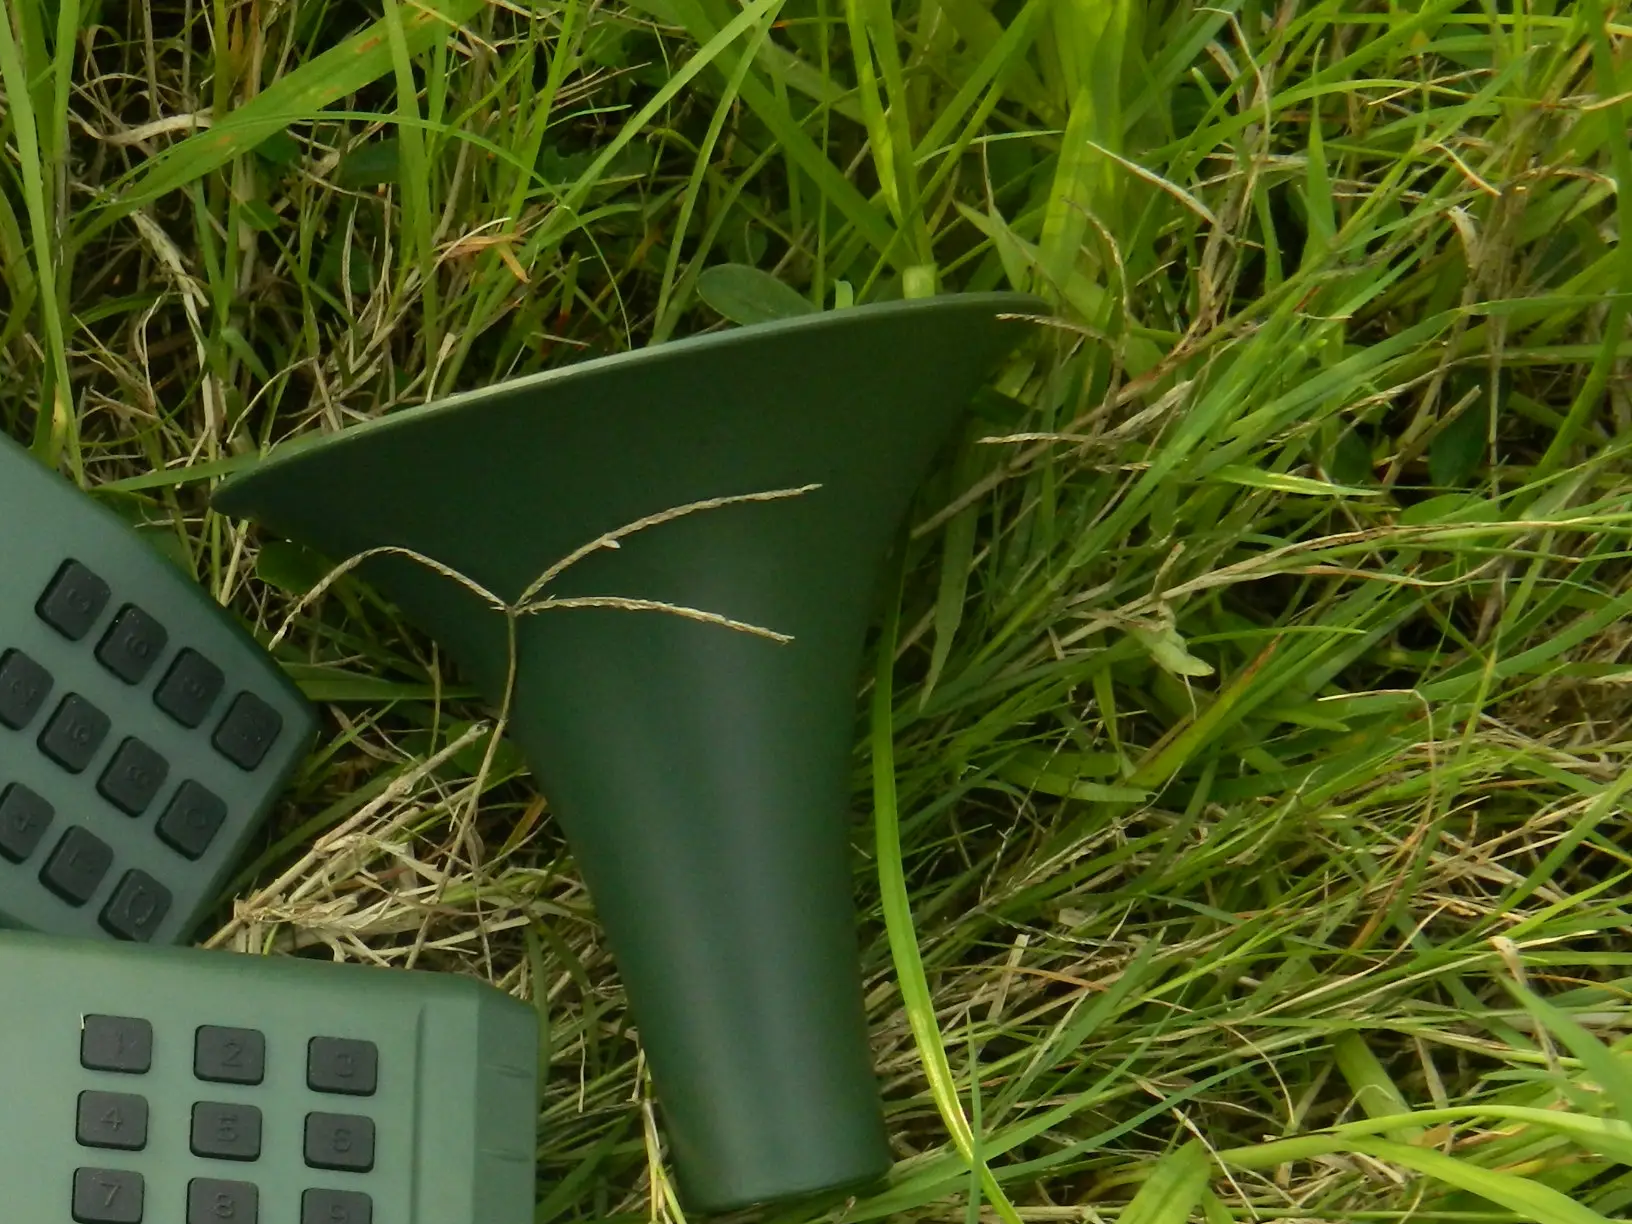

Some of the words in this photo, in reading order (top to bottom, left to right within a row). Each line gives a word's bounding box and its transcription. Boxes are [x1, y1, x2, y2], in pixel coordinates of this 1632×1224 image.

[221, 1041, 245, 1068] 2
[99, 1106, 124, 1133] 4
[217, 1112, 241, 1143] 5
[99, 1178, 123, 1209] 7
[214, 1192, 236, 1220] 8
